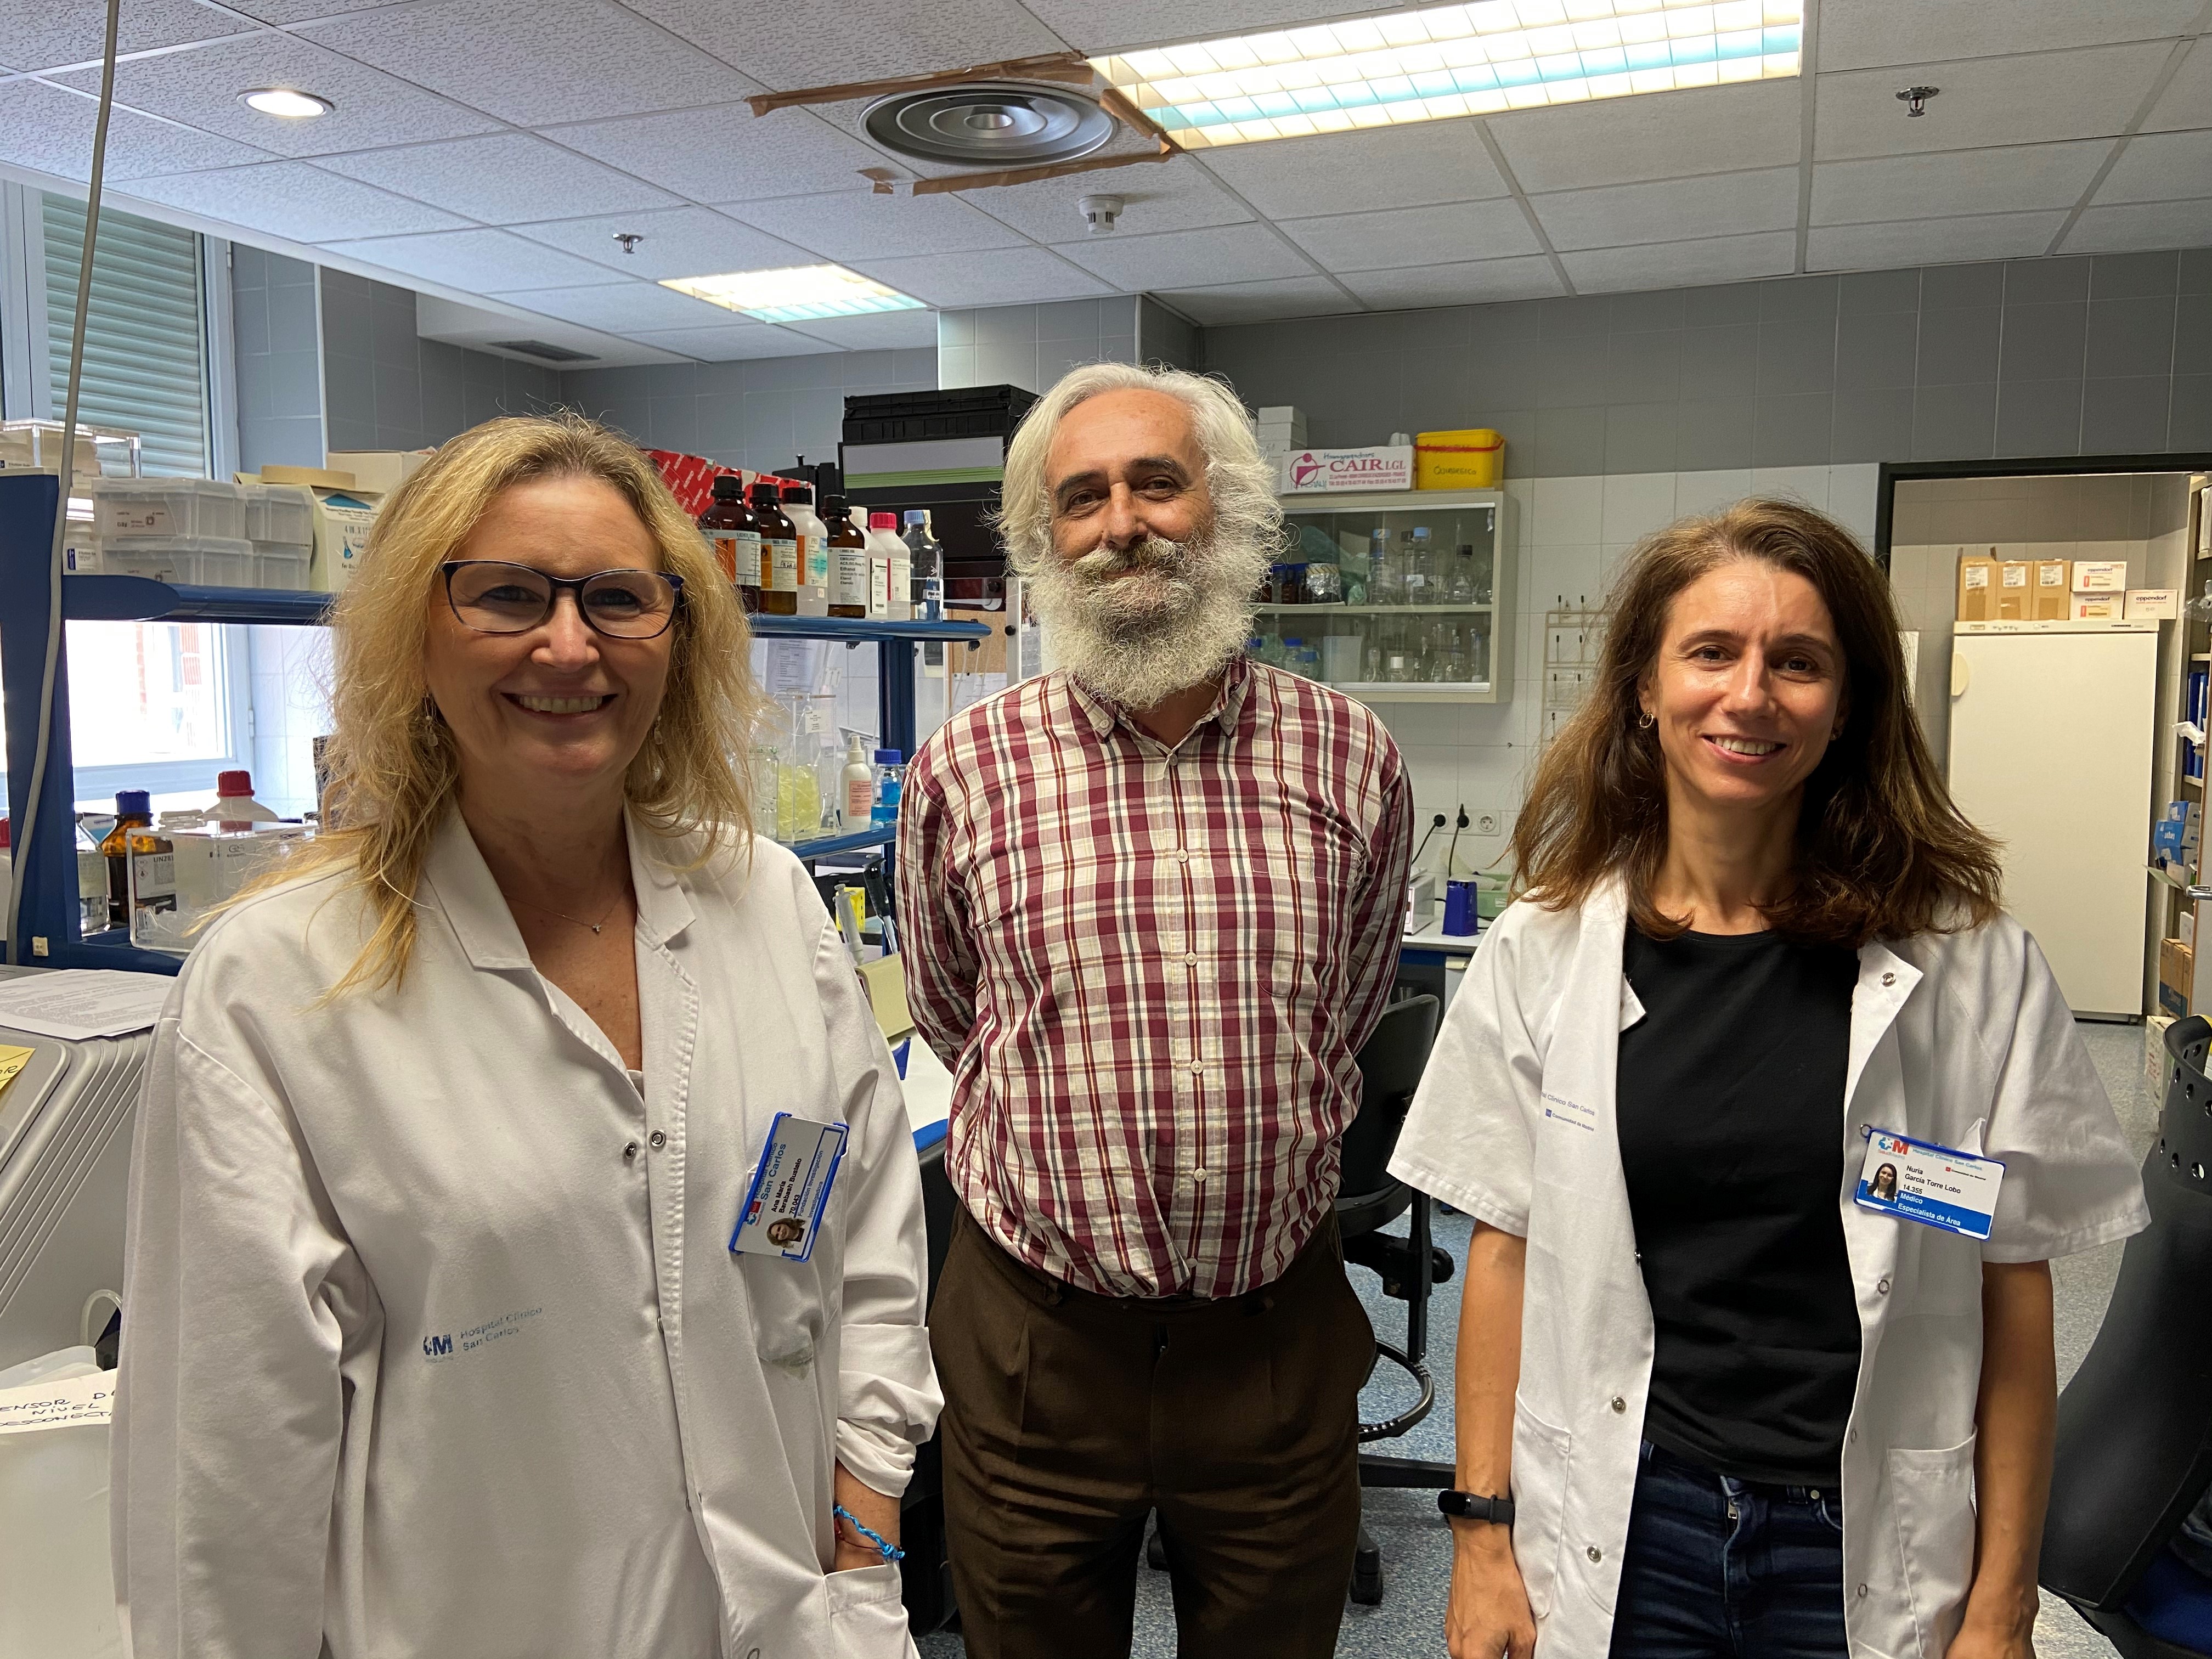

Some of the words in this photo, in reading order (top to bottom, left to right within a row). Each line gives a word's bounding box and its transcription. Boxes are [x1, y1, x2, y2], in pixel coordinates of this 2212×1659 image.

[1330, 459, 1383, 472] CAIR
[1385, 460, 1406, 470] LGL
[761, 1180, 773, 1200] San
[769, 1143, 786, 1178] Carlos
[1906, 1166, 1923, 1175] Nuria
[779, 1183, 793, 1214] Barabash
[789, 1158, 802, 1182] Bustelo
[1903, 1184, 1923, 1194] 14.355
[1905, 1173, 1926, 1184] García
[1926, 1180, 1944, 1189] Torre
[1944, 1184, 1961, 1193] Lobo
[771, 1199, 780, 1212] Ana
[776, 1180, 786, 1199] María
[798, 1187, 811, 1217] Fundación
[808, 1181, 823, 1218] Investigadora
[1900, 1193, 1923, 1204] Médico
[1898, 1204, 1936, 1219] Especialista
[1946, 1216, 1961, 1226] Área
[460, 1317, 503, 1339] Hospital
[463, 1339, 483, 1351] San
[486, 1327, 519, 1341] Carlos
